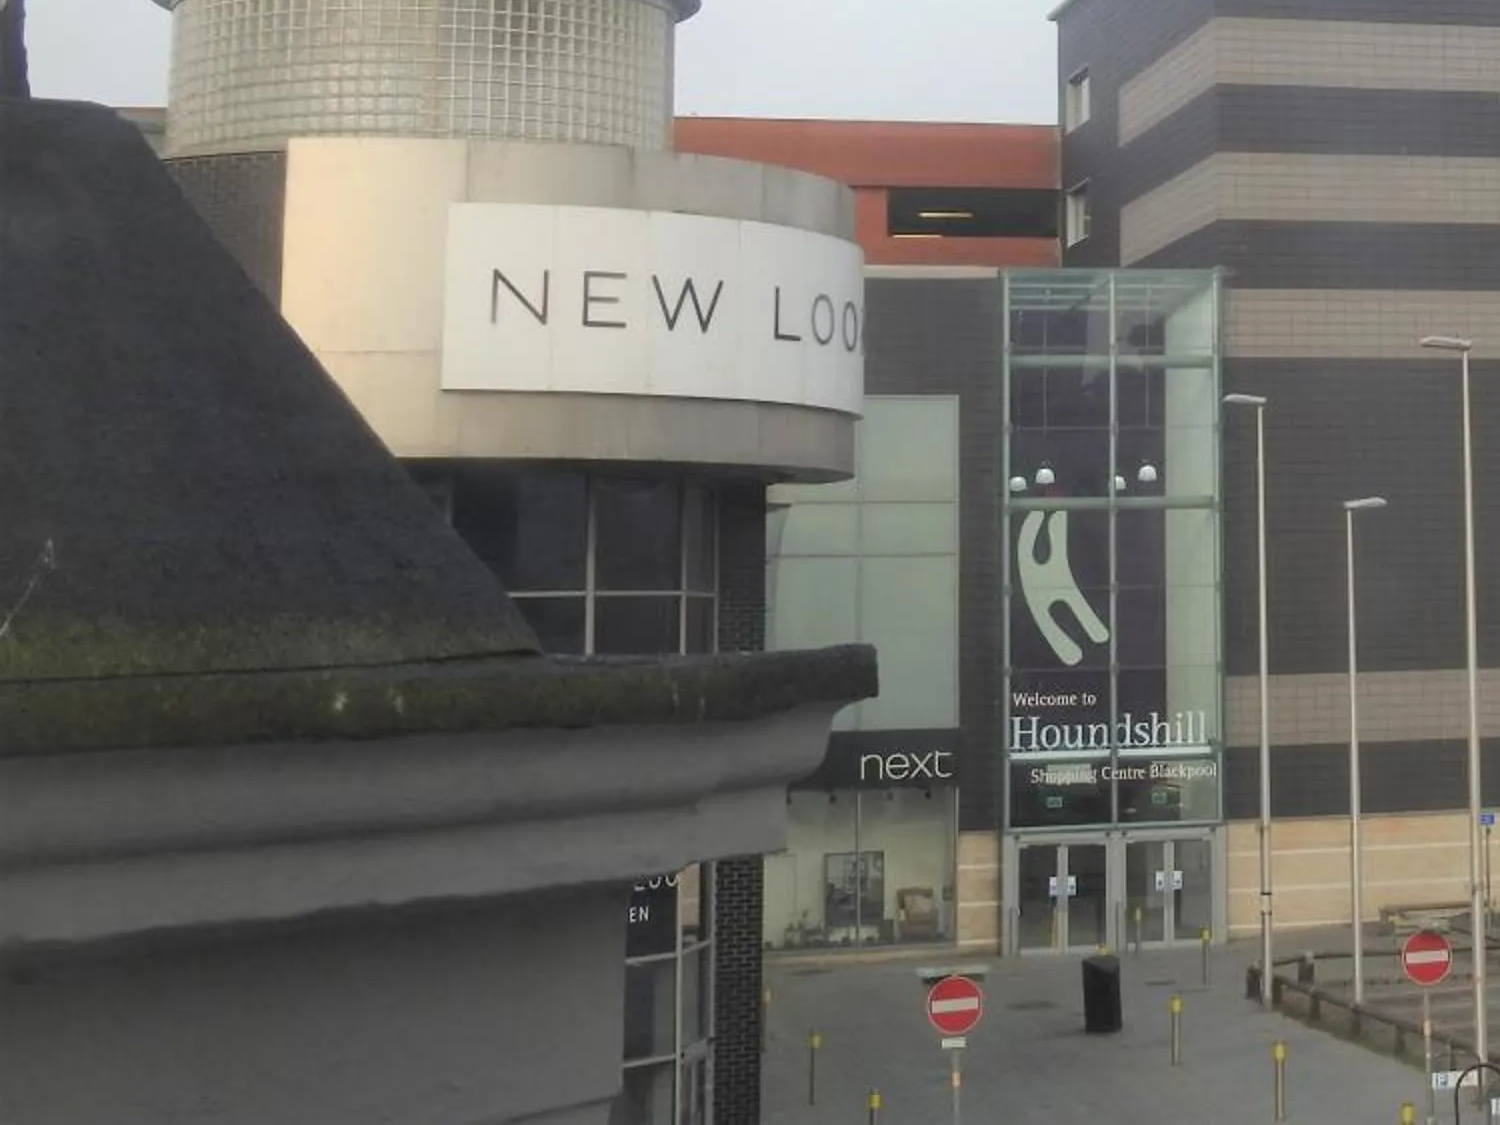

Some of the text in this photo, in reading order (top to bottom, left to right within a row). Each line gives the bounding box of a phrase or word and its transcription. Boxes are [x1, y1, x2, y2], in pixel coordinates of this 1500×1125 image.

[490, 268, 865, 356] NEW LOO
[1012, 691, 1098, 707] Welcome to
[1009, 710, 1207, 751] Houndshill
[860, 750, 953, 780] next
[1100, 765, 1146, 781] Centre
[1149, 761, 1217, 780] Blackpool
[628, 906, 650, 924] EN
